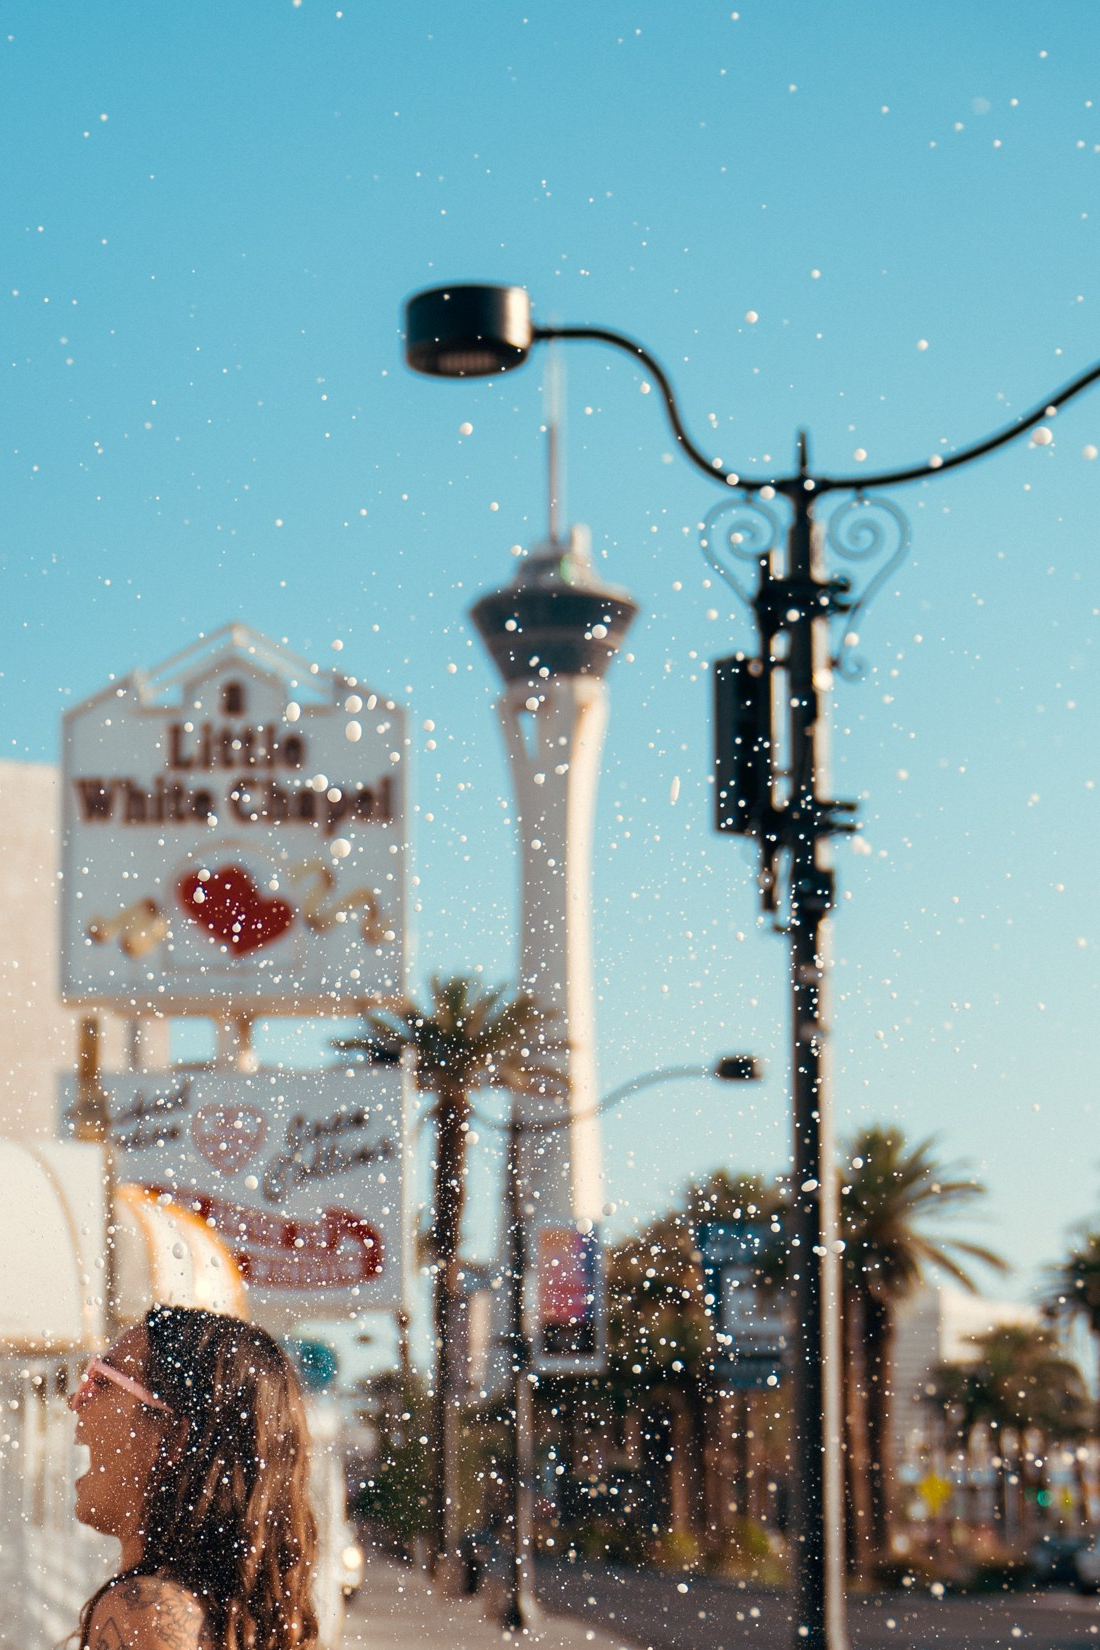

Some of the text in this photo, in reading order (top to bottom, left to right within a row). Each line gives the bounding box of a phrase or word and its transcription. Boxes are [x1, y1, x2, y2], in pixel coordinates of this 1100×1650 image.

[166, 722, 307, 772] Little
[72, 774, 396, 838] White Chapel
